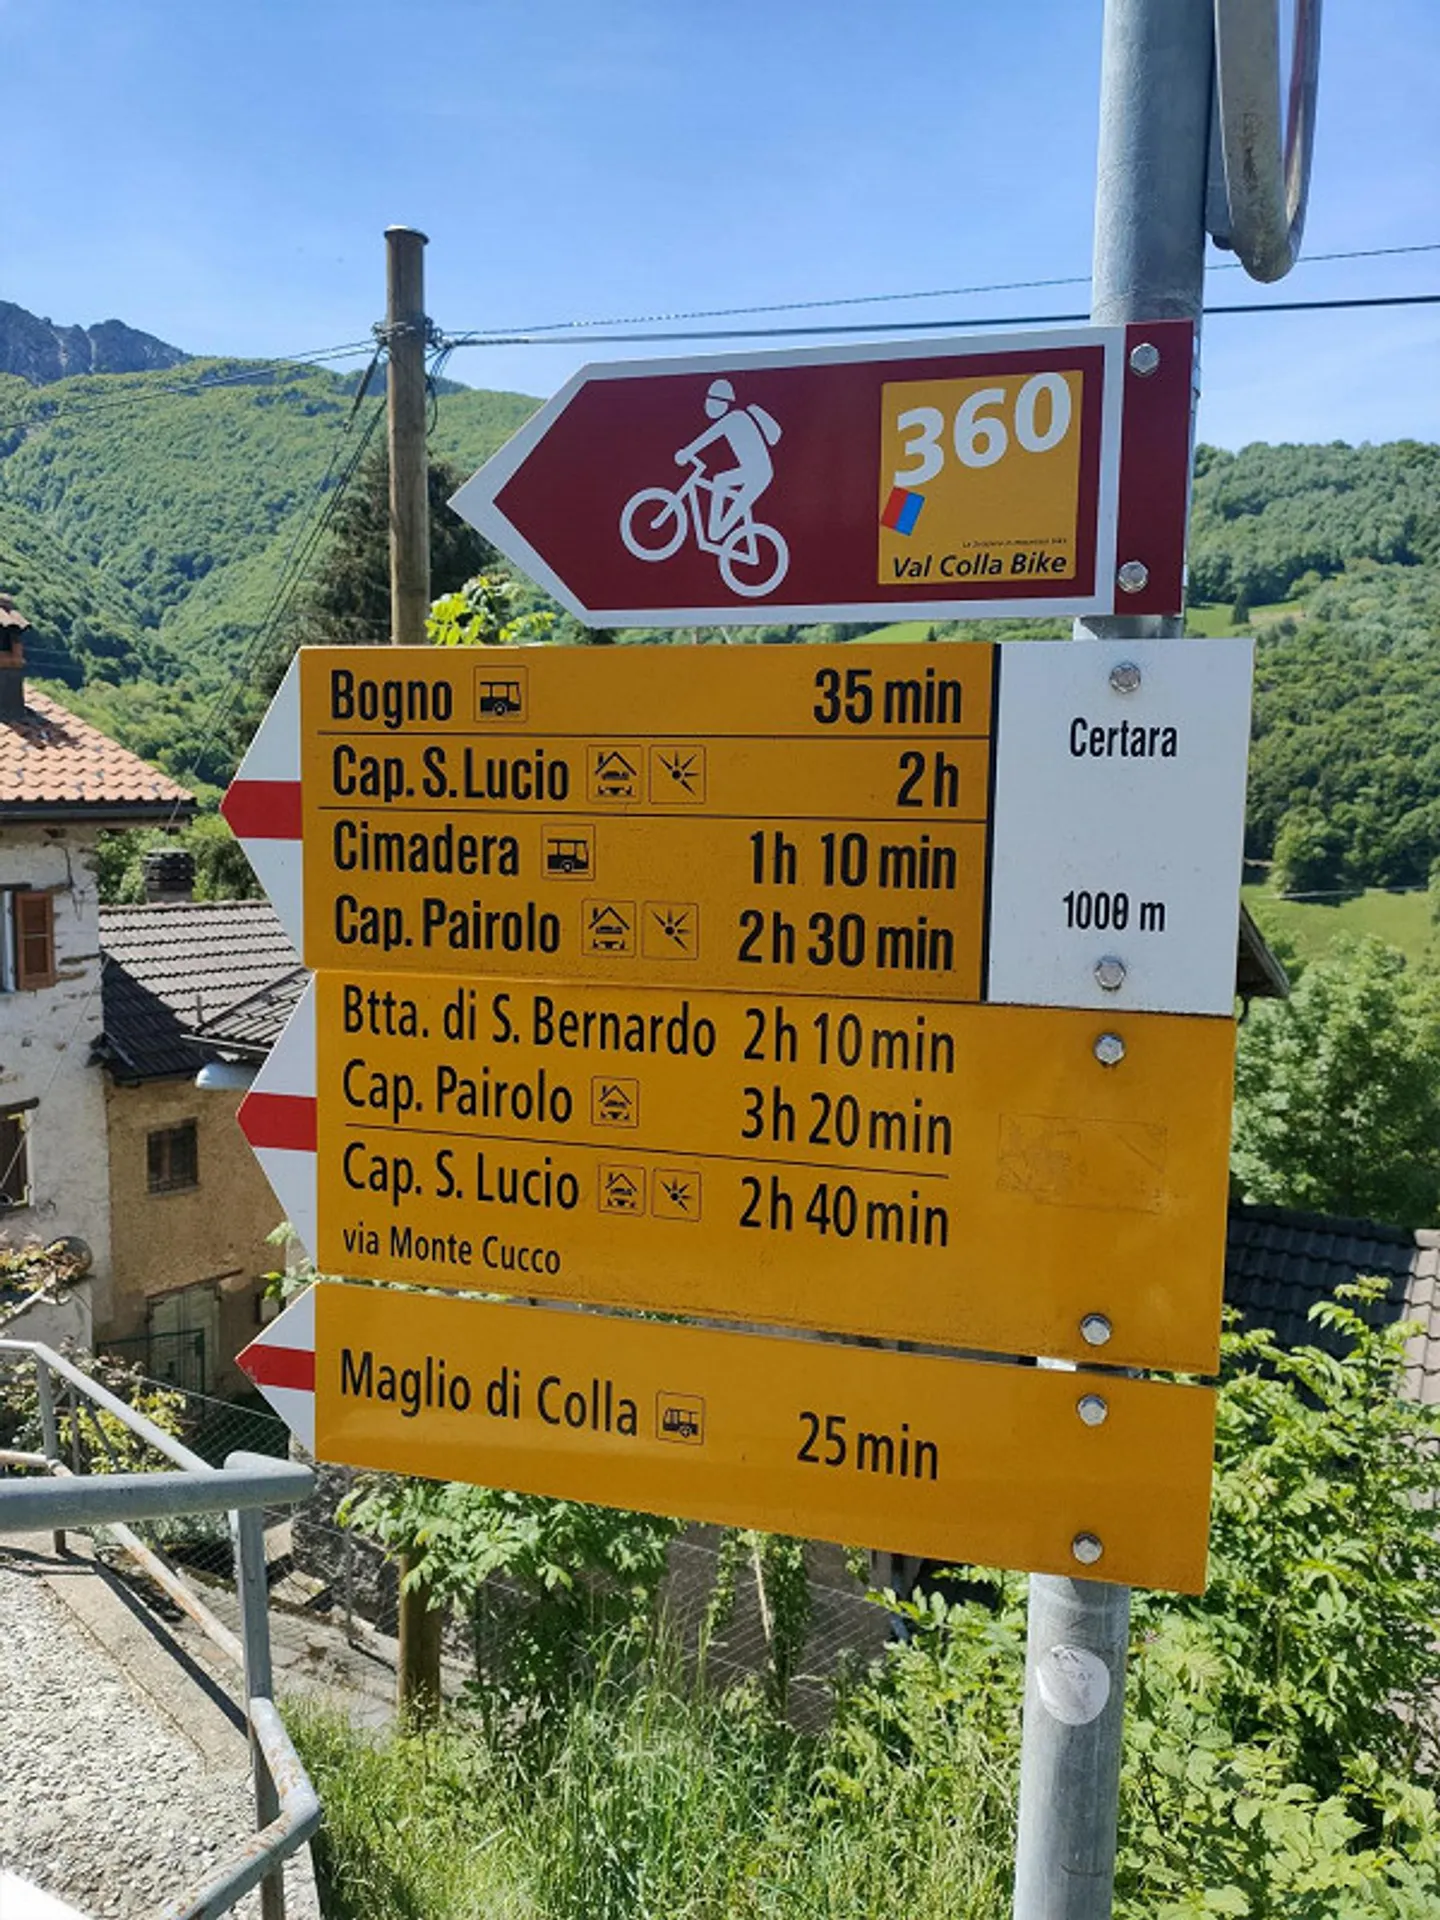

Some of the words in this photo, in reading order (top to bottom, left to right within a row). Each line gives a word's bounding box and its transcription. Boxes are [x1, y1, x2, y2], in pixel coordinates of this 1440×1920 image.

[893, 372, 1072, 487] 360
[892, 555, 932, 578] Val
[939, 552, 1003, 577] Colla
[1010, 550, 1067, 574] Bike
[331, 669, 453, 729] Bogno
[1069, 717, 1178, 757] Certara
[333, 744, 415, 802] Cap.
[333, 820, 520, 876] Cimadera
[334, 895, 413, 952] Cap.
[422, 897, 561, 953] Pairolo
[1140, 900, 1166, 932] m
[343, 983, 429, 1039] Btta.
[443, 987, 477, 1041] di
[492, 993, 520, 1044] S.
[533, 995, 717, 1058] Bernardo
[343, 1058, 423, 1123] Cap.
[437, 1064, 573, 1123] Pairolo
[343, 1141, 422, 1207] Cap.
[435, 1149, 463, 1199] S.
[477, 1151, 579, 1210] Lucio
[342, 1221, 379, 1255] via
[390, 1225, 472, 1266] Monte
[482, 1235, 561, 1275] Cucco
[341, 1348, 471, 1418] Maglio
[486, 1365, 520, 1419] di
[537, 1375, 638, 1436] Colla
